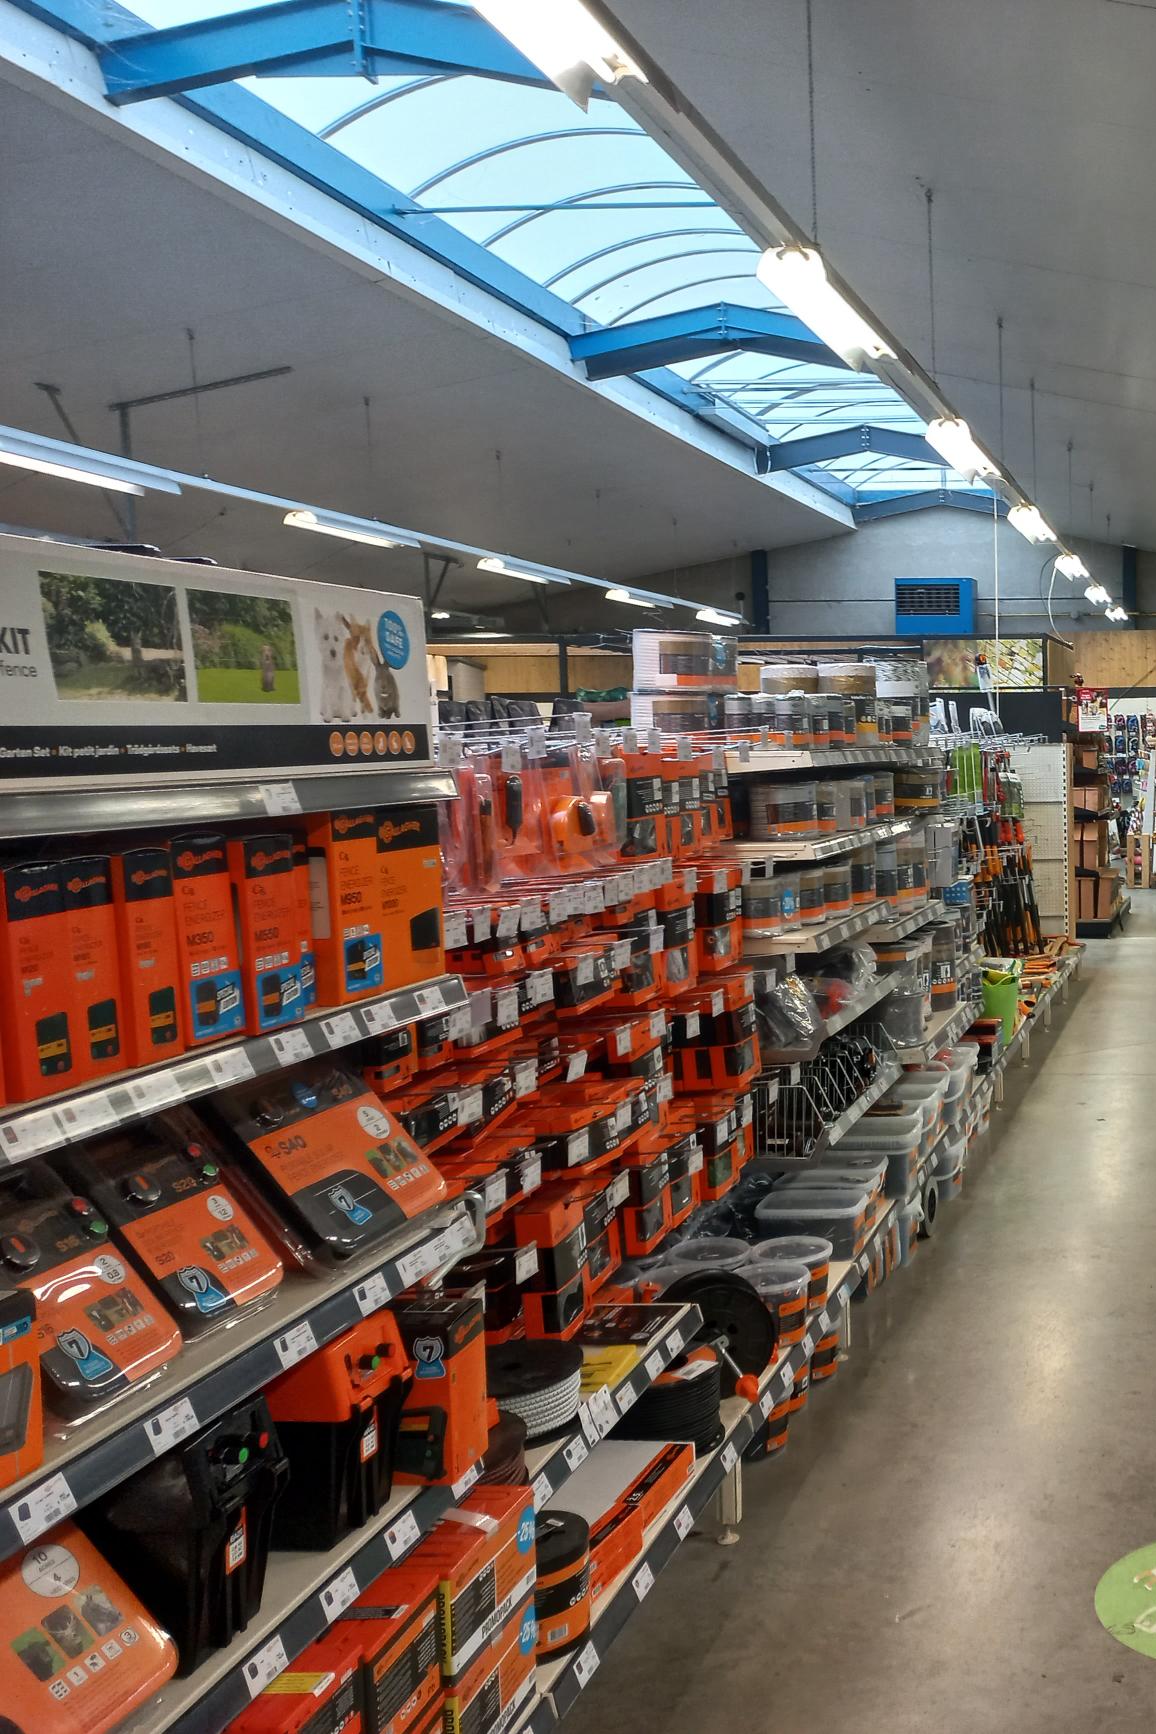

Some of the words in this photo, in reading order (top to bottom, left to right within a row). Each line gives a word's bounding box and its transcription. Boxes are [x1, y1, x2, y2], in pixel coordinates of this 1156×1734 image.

[0, 627, 30, 655] KIT
[278, 1135, 308, 1155] S40
[188, 1275, 204, 1293] 7
[67, 1338, 85, 1358] 7
[422, 1345, 434, 1364] 7
[32, 1551, 48, 1566] 10
[481, 1594, 513, 1640] PROMOPACK
